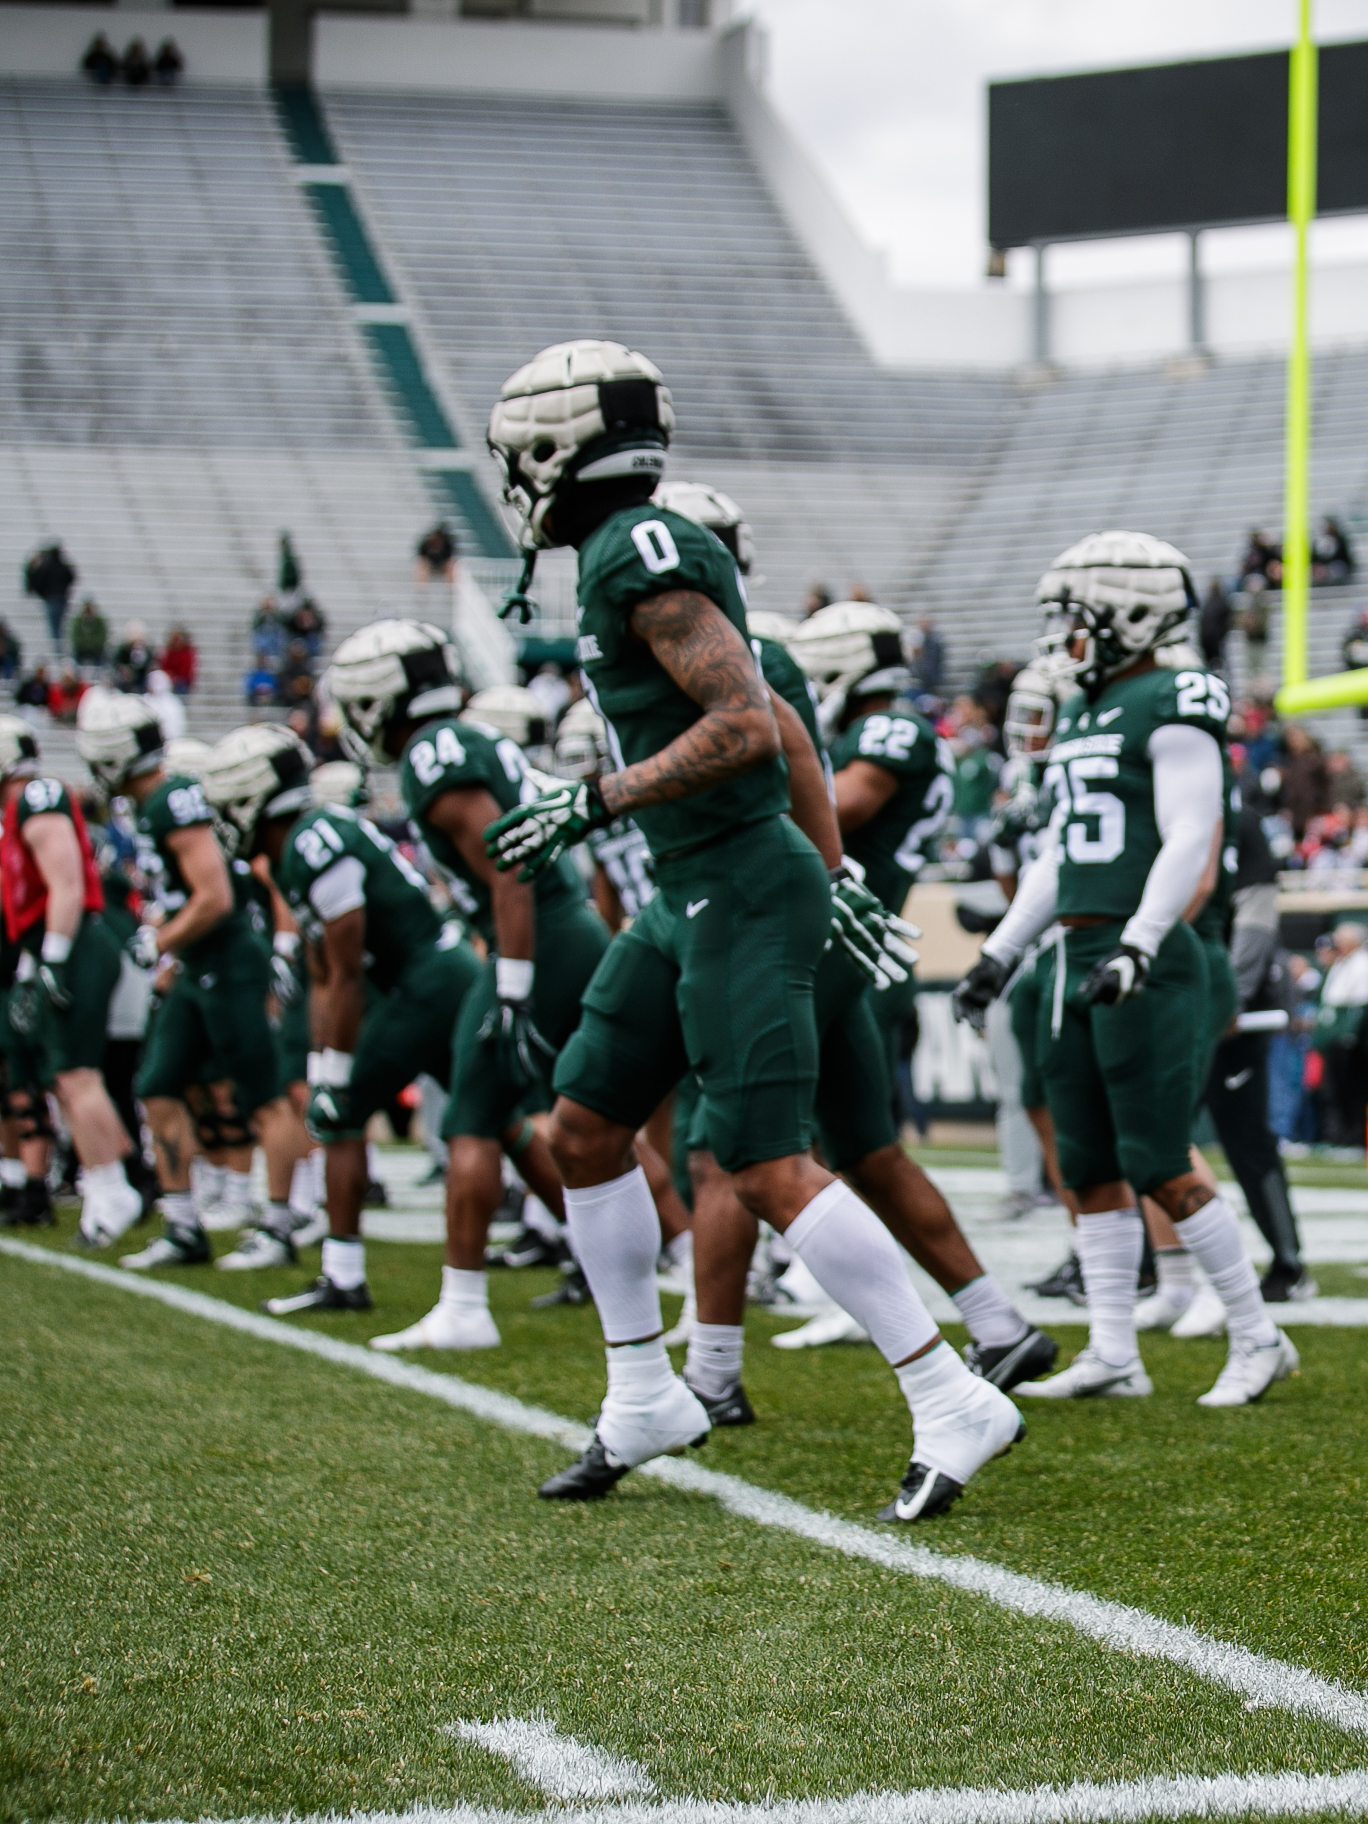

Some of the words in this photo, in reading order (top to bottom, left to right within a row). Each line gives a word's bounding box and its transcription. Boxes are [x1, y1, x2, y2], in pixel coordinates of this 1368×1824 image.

[631, 519, 680, 574] 0
[1175, 671, 1230, 722] 25
[409, 727, 467, 787] 24
[858, 715, 919, 761] 22
[294, 818, 345, 870] 21
